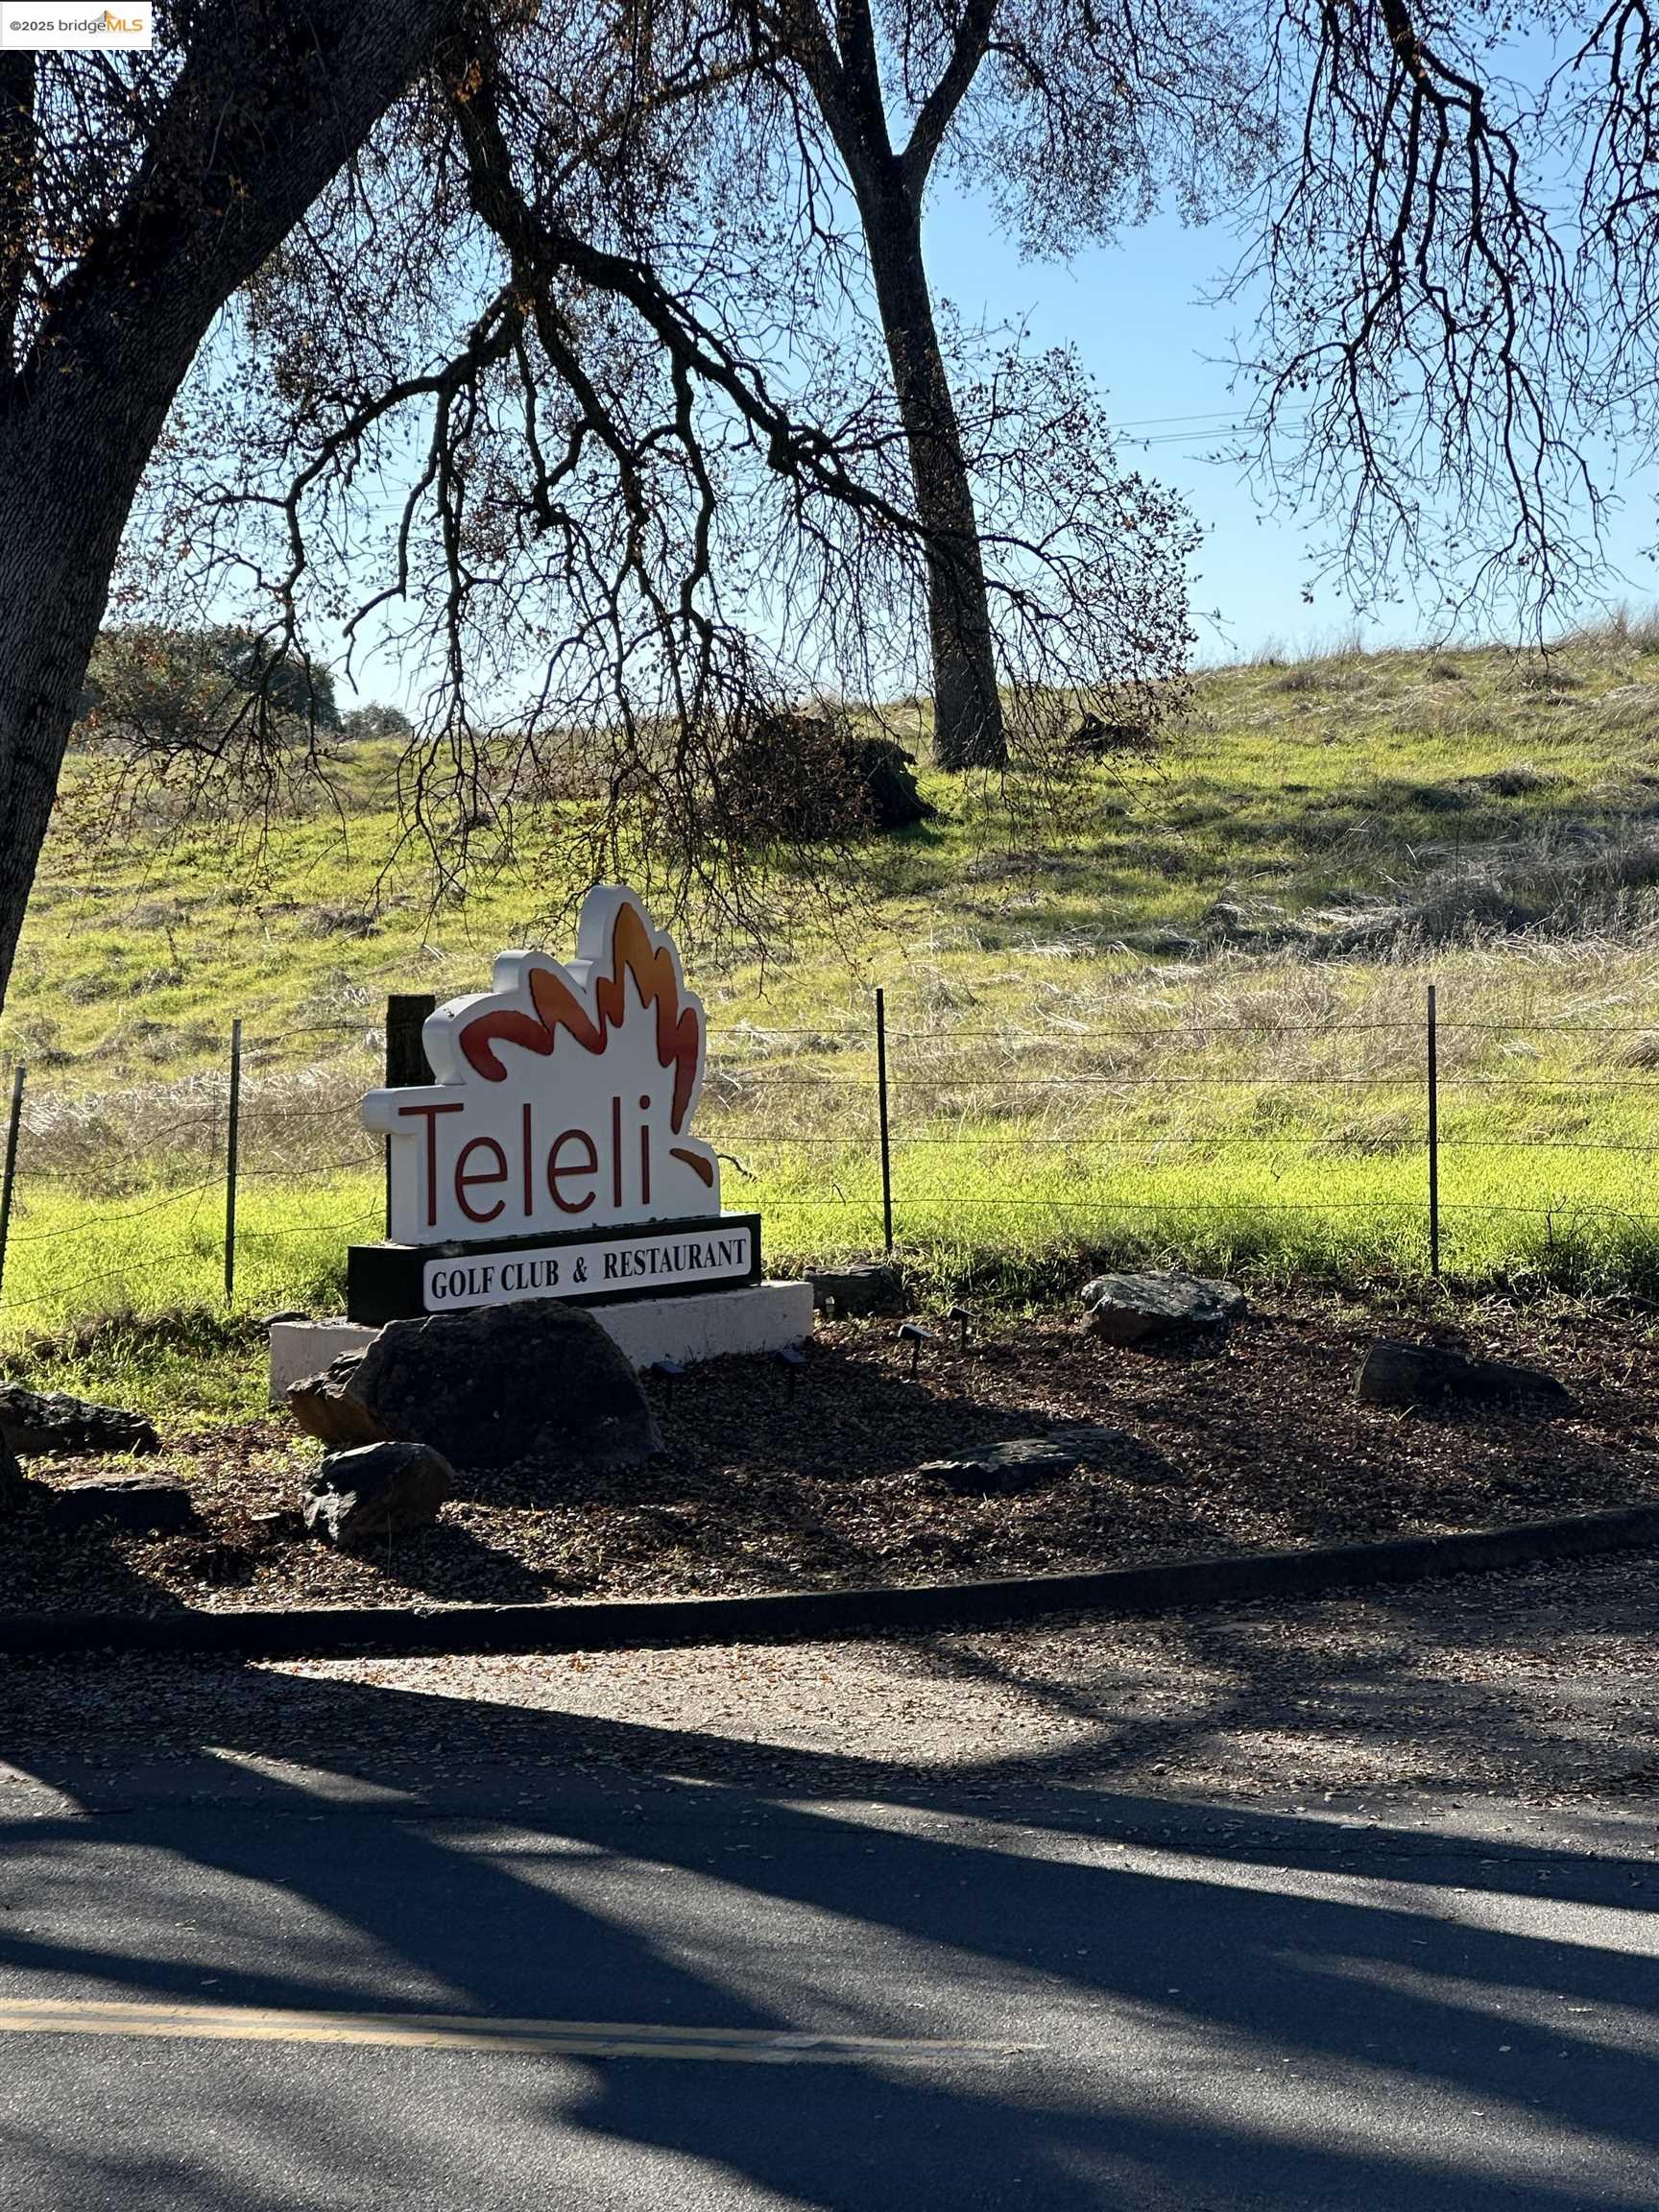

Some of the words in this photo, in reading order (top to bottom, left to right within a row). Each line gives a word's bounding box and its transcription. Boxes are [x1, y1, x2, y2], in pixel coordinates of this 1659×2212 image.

[398, 1094, 651, 1226] Teleli
[431, 1265, 495, 1300] GOLF
[500, 1259, 559, 1291] CLUB
[572, 1256, 589, 1284] &
[603, 1238, 747, 1280] RESTAURANT
